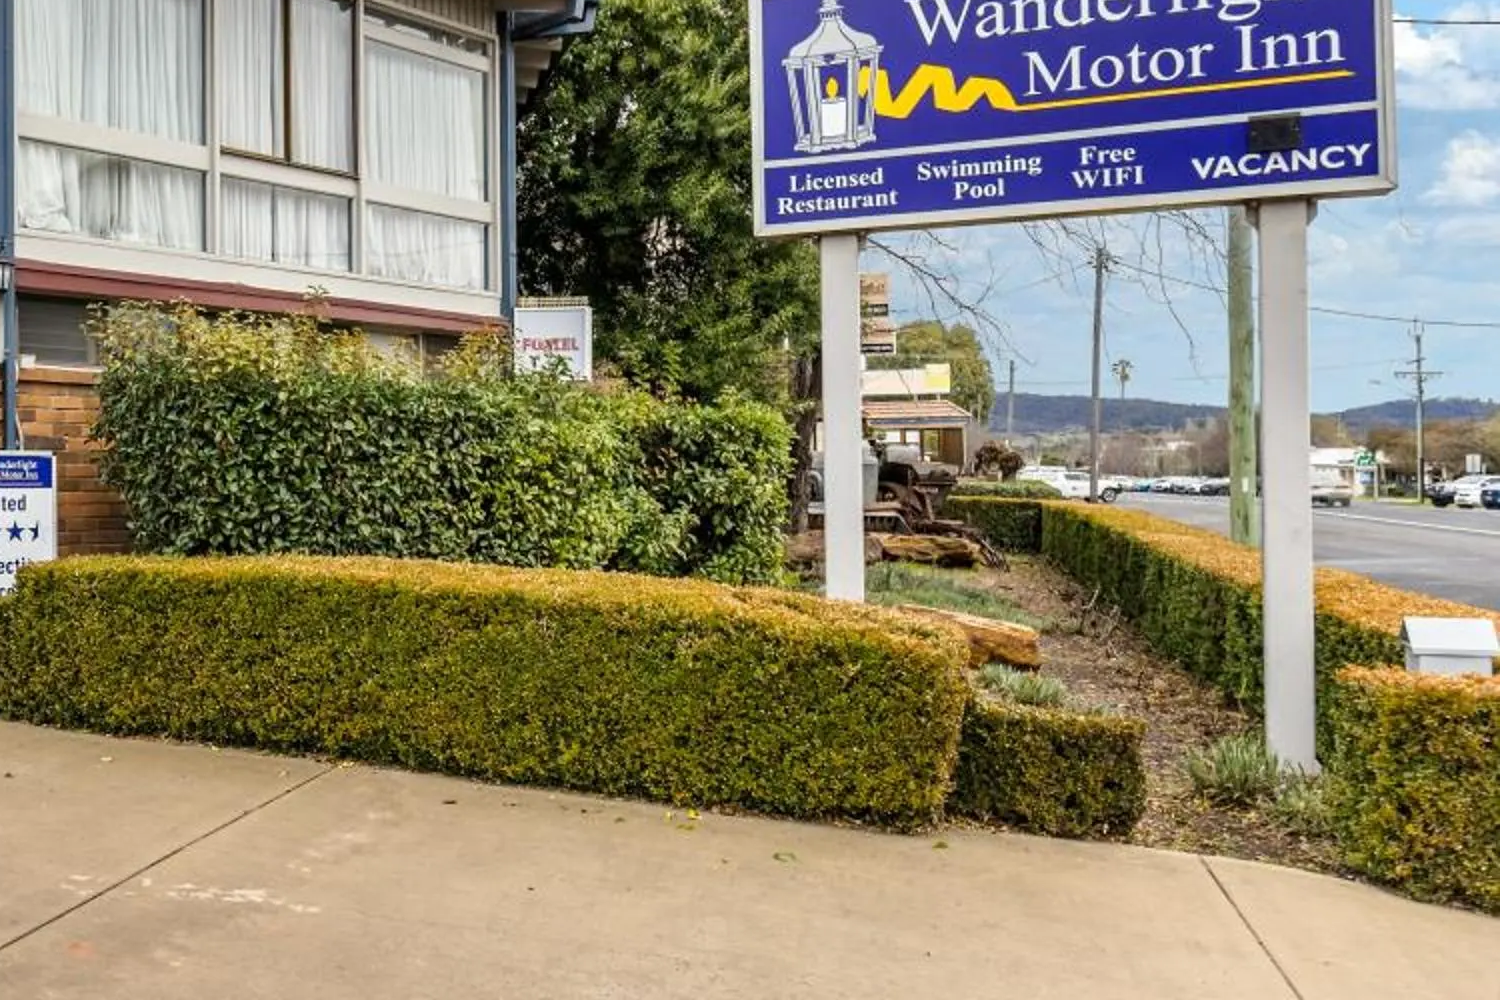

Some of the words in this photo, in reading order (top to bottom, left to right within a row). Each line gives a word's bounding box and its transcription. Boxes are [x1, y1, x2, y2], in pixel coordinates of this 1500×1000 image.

[1022, 41, 1215, 97] Motor
[1233, 23, 1347, 74] Inn
[916, 154, 1043, 181] Swimming
[1080, 144, 1137, 166] Free
[1191, 142, 1371, 181] VACANCY
[789, 167, 884, 194] Licensed
[953, 177, 1005, 201] Pool
[1071, 165, 1145, 189] WIFI
[776, 188, 899, 216] Restaurant
